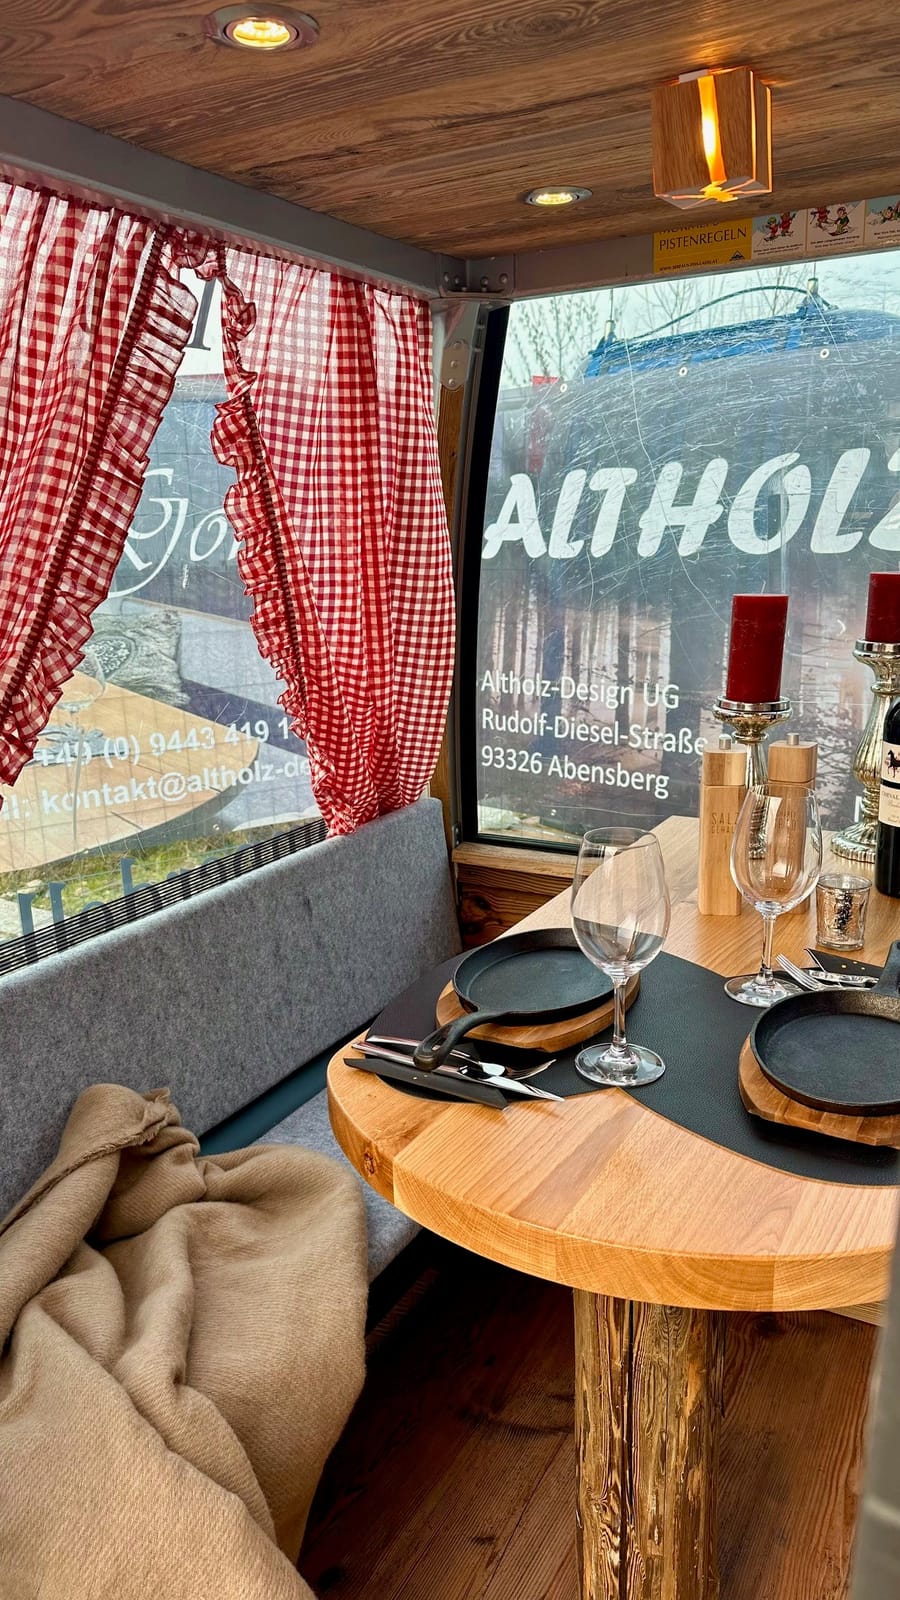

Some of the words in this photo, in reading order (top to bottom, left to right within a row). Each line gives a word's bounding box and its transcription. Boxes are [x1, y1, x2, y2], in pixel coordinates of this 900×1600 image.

[658, 228, 748, 251] PISTENREGELN
[481, 670, 634, 709] Altholz-Design
[643, 683, 680, 709] UG
[104, 735, 140, 768] (0)
[149, 726, 215, 756] 9443
[224, 719, 270, 745] 419
[481, 708, 709, 757] Rudolf-Diesel-Straße
[481, 745, 543, 775] 93326
[548, 754, 670, 799] Abensberg
